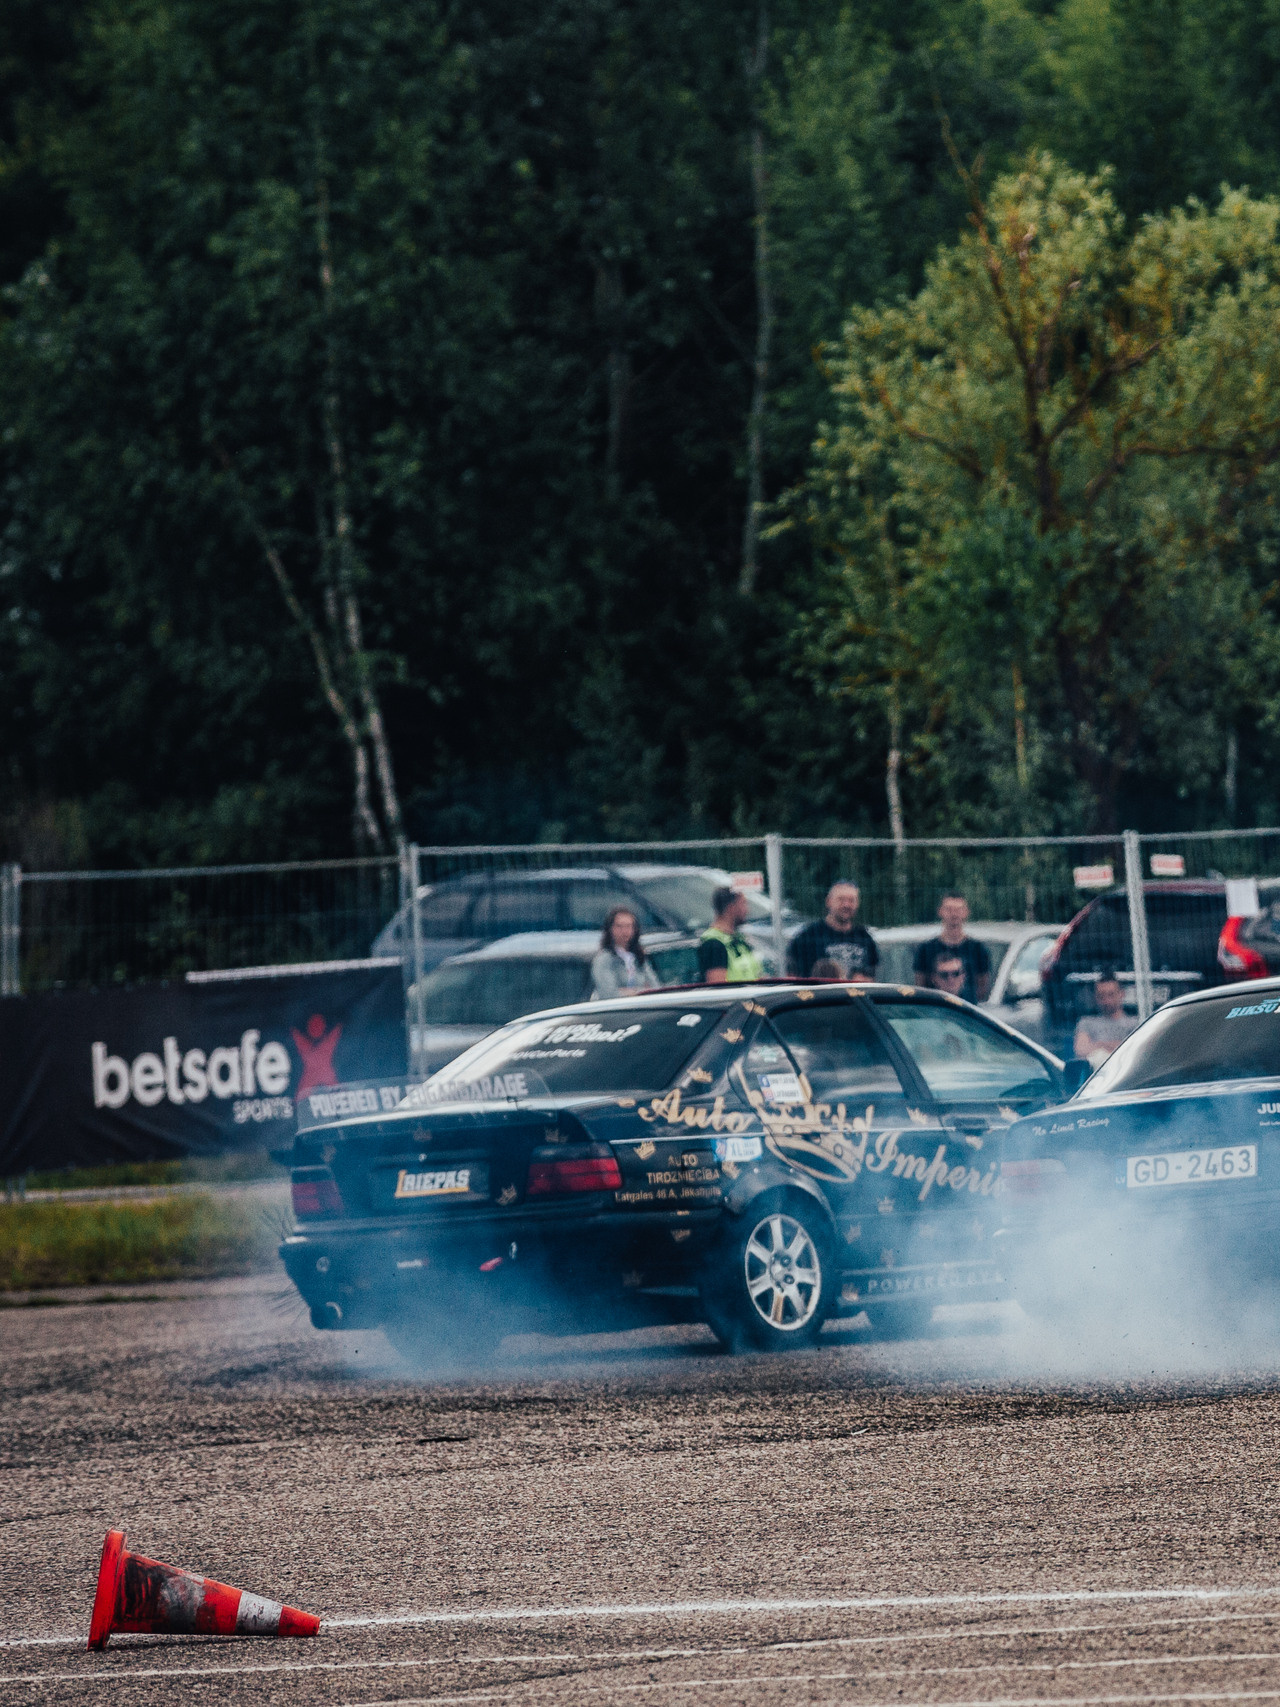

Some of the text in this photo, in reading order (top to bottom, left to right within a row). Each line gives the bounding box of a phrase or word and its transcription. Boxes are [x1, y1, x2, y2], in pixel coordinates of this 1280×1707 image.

[91, 1028, 291, 1110] betsafe
[379, 1085, 402, 1110] BY
[637, 1088, 754, 1134] Auto
[1076, 1116, 1110, 1131] Racing
[667, 1153, 699, 1167] AUTO
